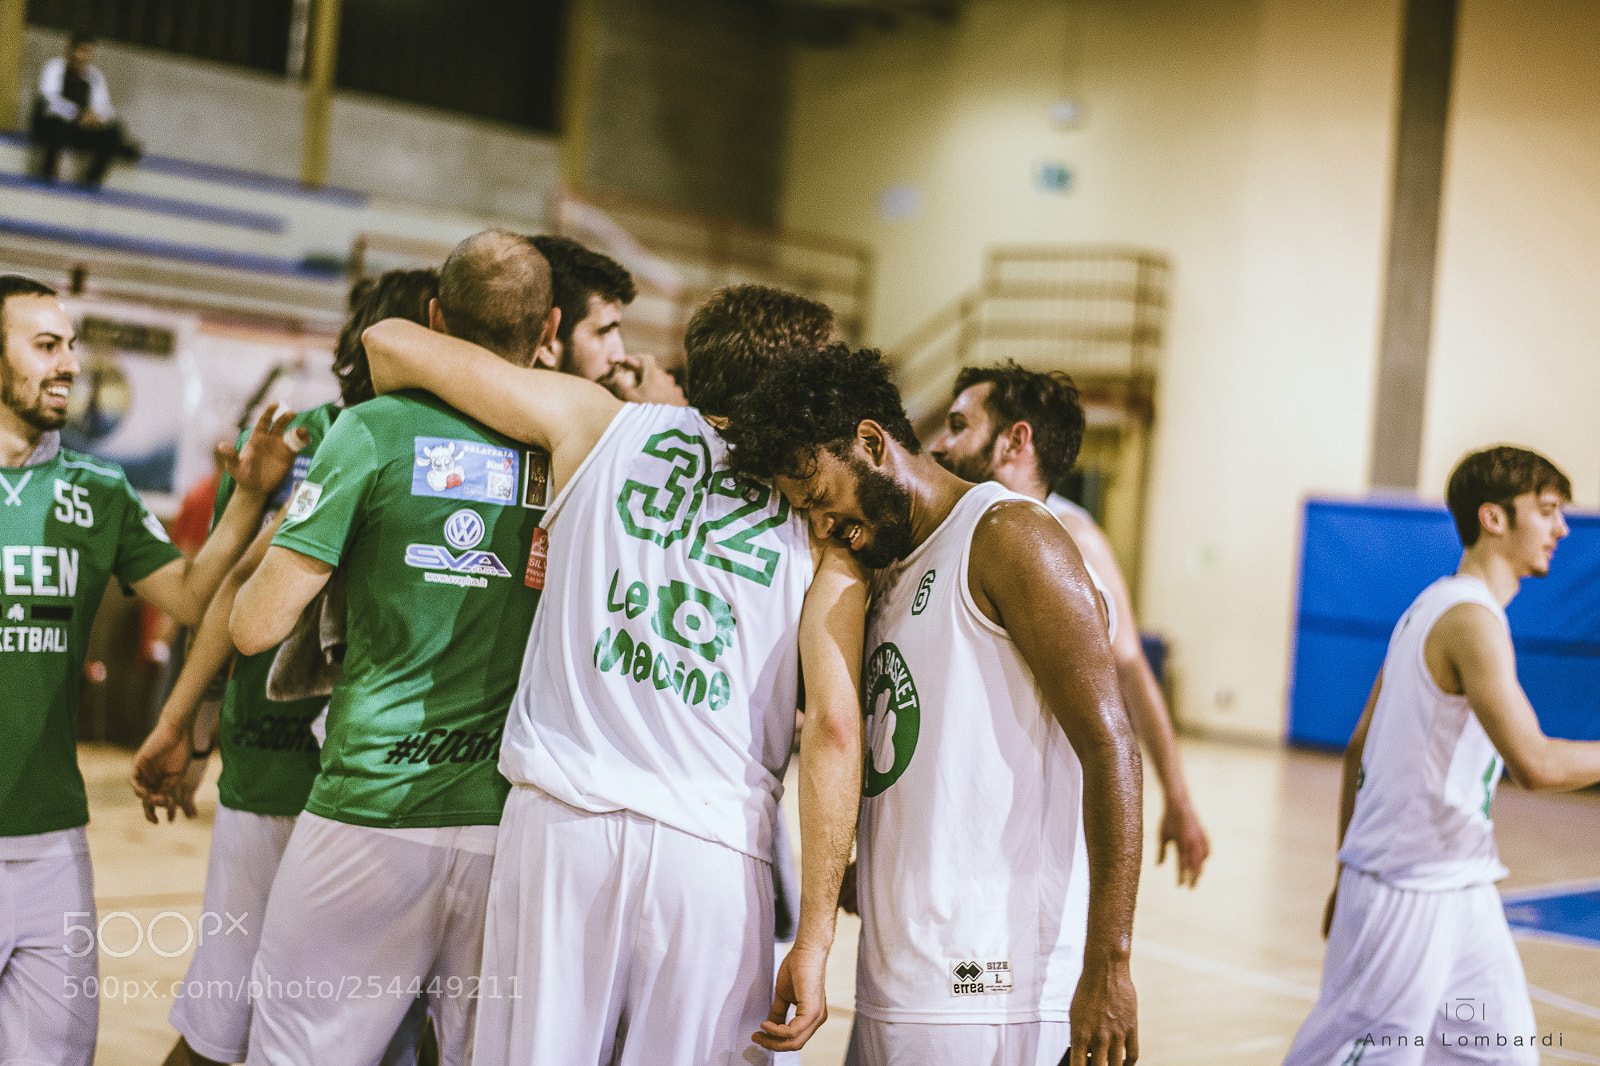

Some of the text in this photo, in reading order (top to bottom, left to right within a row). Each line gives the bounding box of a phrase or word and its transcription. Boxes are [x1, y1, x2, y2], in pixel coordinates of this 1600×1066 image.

[53, 478, 94, 528] 55
[616, 428, 791, 587] 32
[0, 546, 79, 597] EEN
[405, 543, 512, 577] SVA
[607, 568, 649, 620] Le
[912, 569, 936, 615] 6
[0, 627, 68, 652] ETBALL
[885, 649, 917, 710] BASKET
[953, 982, 984, 994] errea
[986, 961, 1008, 970] SIZE
[994, 974, 1003, 984] L
